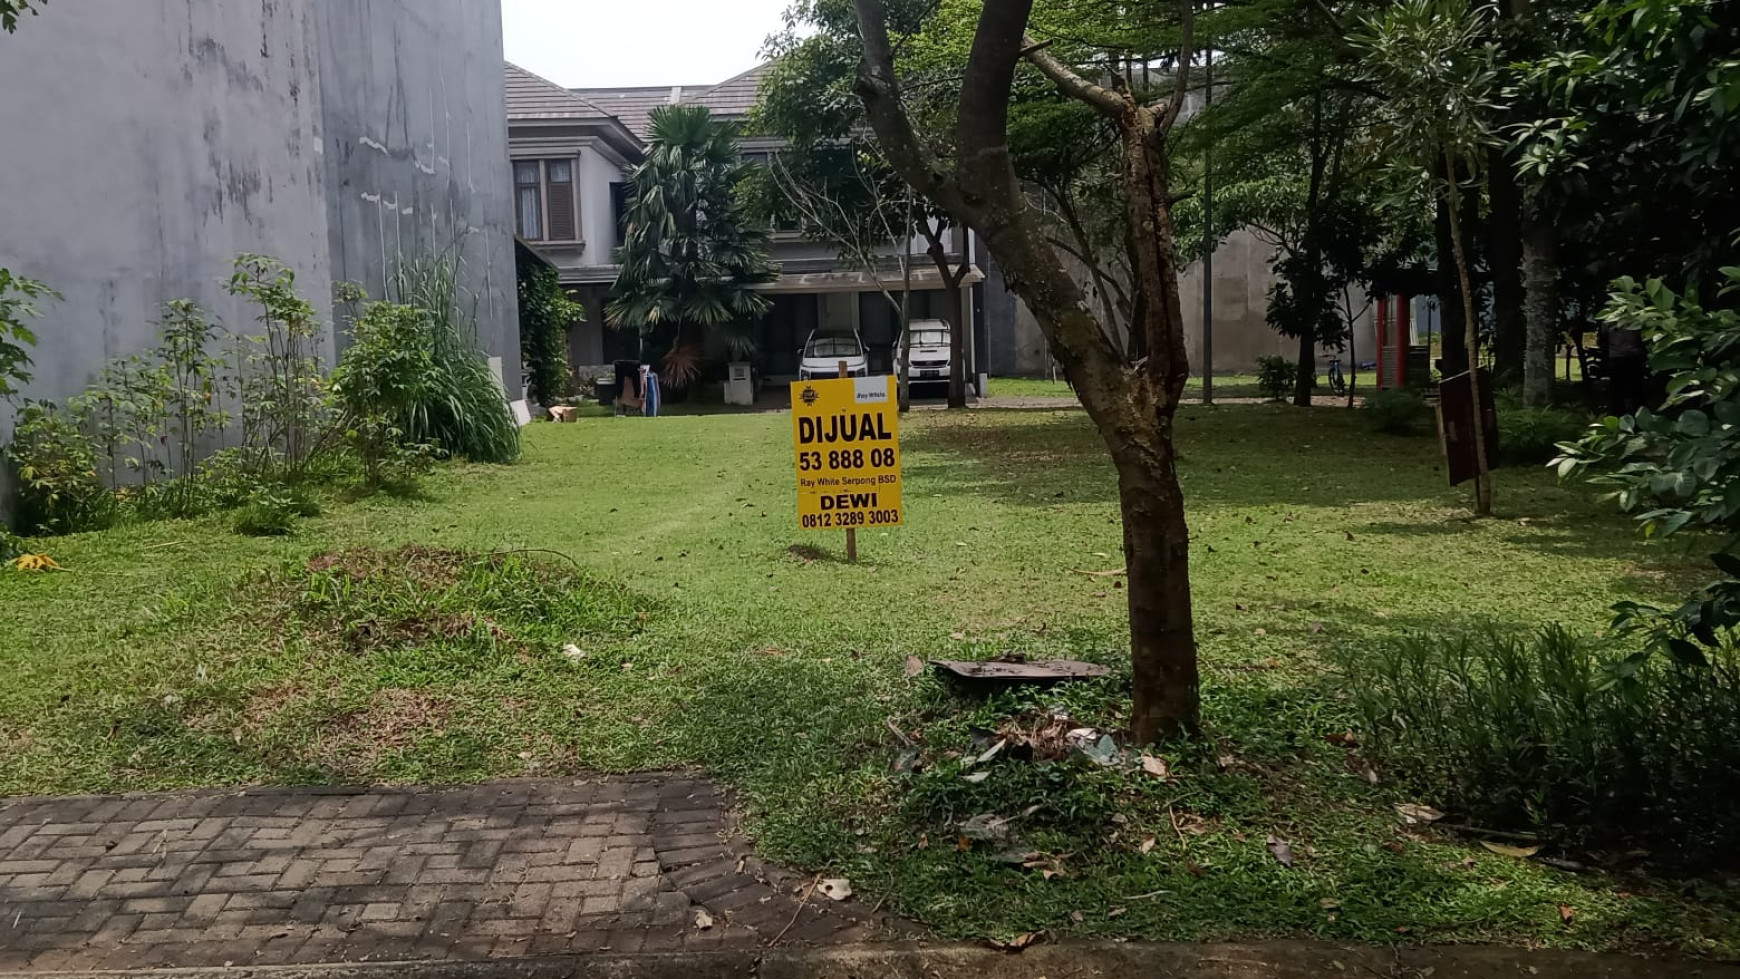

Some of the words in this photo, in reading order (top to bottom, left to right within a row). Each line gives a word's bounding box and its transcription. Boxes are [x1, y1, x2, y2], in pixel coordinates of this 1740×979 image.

[798, 413, 892, 444] DIJUAL
[800, 452, 822, 471] 53
[829, 449, 864, 469] 888
[871, 448, 895, 467] 08
[800, 479, 815, 487] Ray
[818, 478, 839, 486] White
[842, 476, 876, 485] Serpong
[879, 475, 896, 483] BSD
[820, 493, 877, 510] DEWI
[802, 514, 831, 528] 0812
[836, 511, 864, 525] 3289
[869, 509, 898, 524] 3003
